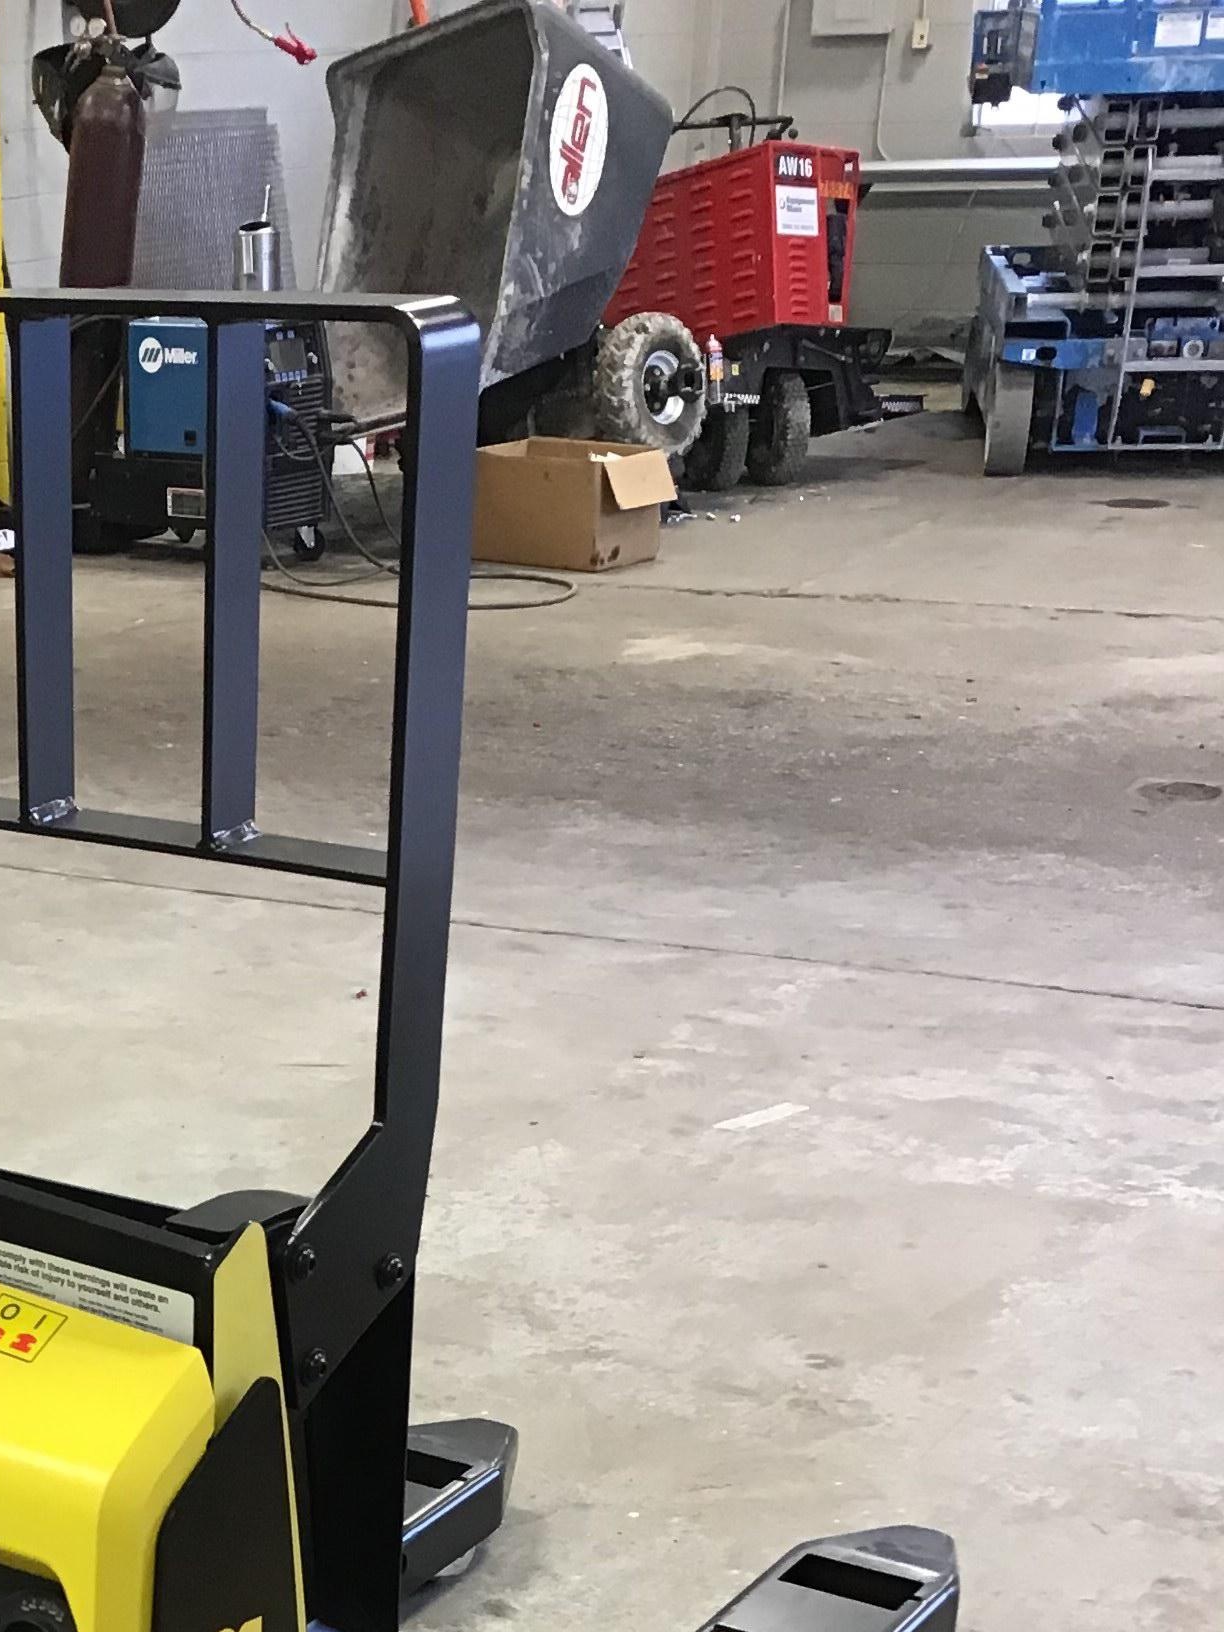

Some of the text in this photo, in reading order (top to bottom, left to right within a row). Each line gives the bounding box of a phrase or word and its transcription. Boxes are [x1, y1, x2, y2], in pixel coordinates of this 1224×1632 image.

[778, 155, 813, 178] AW16
[164, 347, 198, 365] Miller
[14, 1264, 29, 1274] risk
[31, 1270, 39, 1278] of
[41, 1272, 65, 1288] injury
[66, 1279, 75, 1289] to
[78, 1283, 111, 1299] yourself
[113, 1294, 129, 1304] and
[29, 1258, 46, 1269] with
[48, 1262, 70, 1275] these
[73, 1271, 110, 1288] warnings
[113, 1282, 127, 1292] will
[129, 1287, 156, 1300] create
